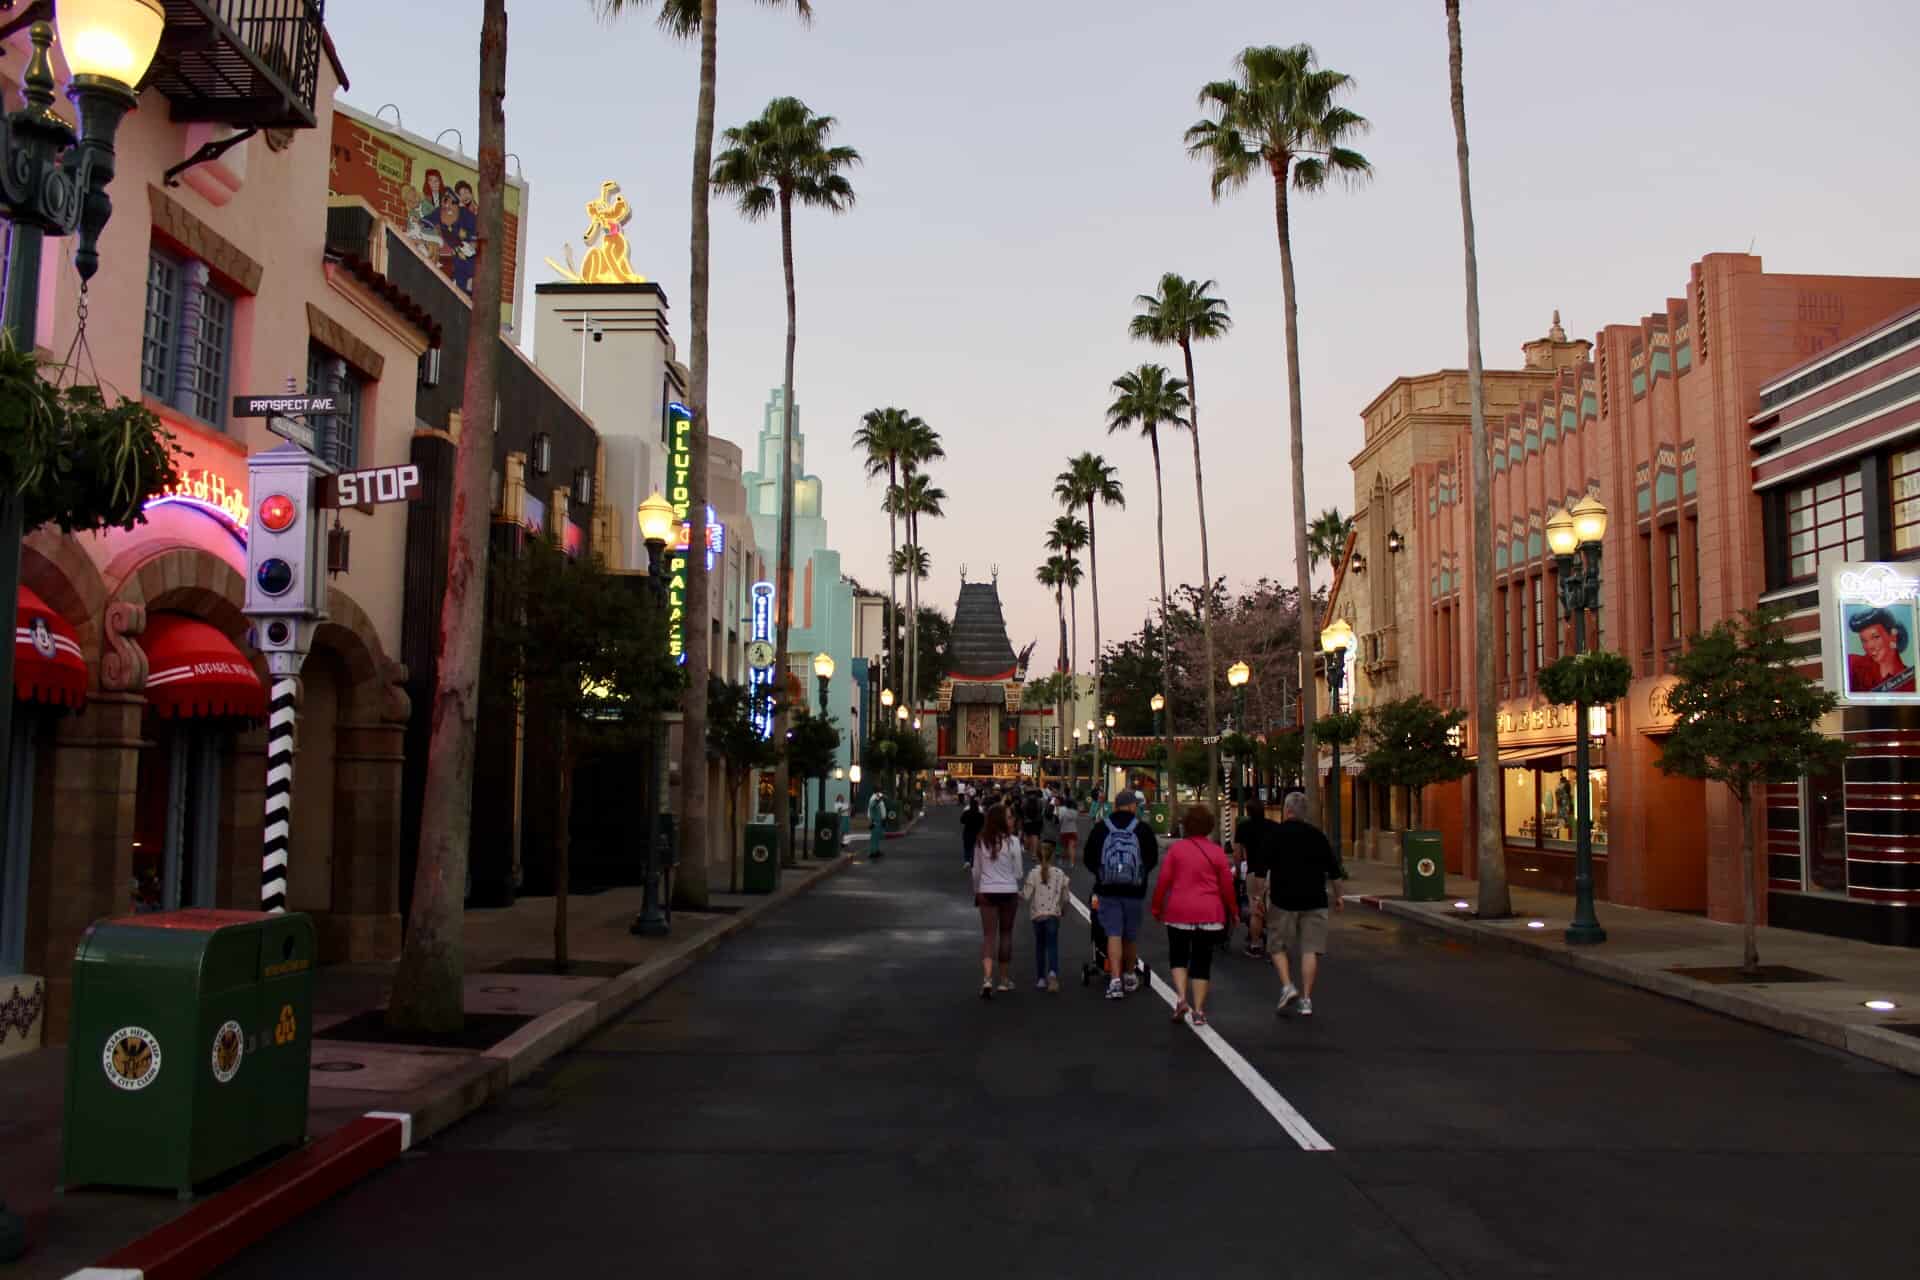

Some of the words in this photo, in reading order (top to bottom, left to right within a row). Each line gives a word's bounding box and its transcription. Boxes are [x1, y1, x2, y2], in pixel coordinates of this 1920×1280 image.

[249, 399, 310, 412] PROSPECT
[337, 465, 419, 506] STOP
[1202, 735, 1222, 745] STOP
[106, 1030, 127, 1053] PLEASE
[130, 1028, 149, 1038] HELP
[106, 1062, 118, 1079] OUR
[118, 1079, 135, 1088] CITY
[136, 1066, 158, 1087] CLEAN
